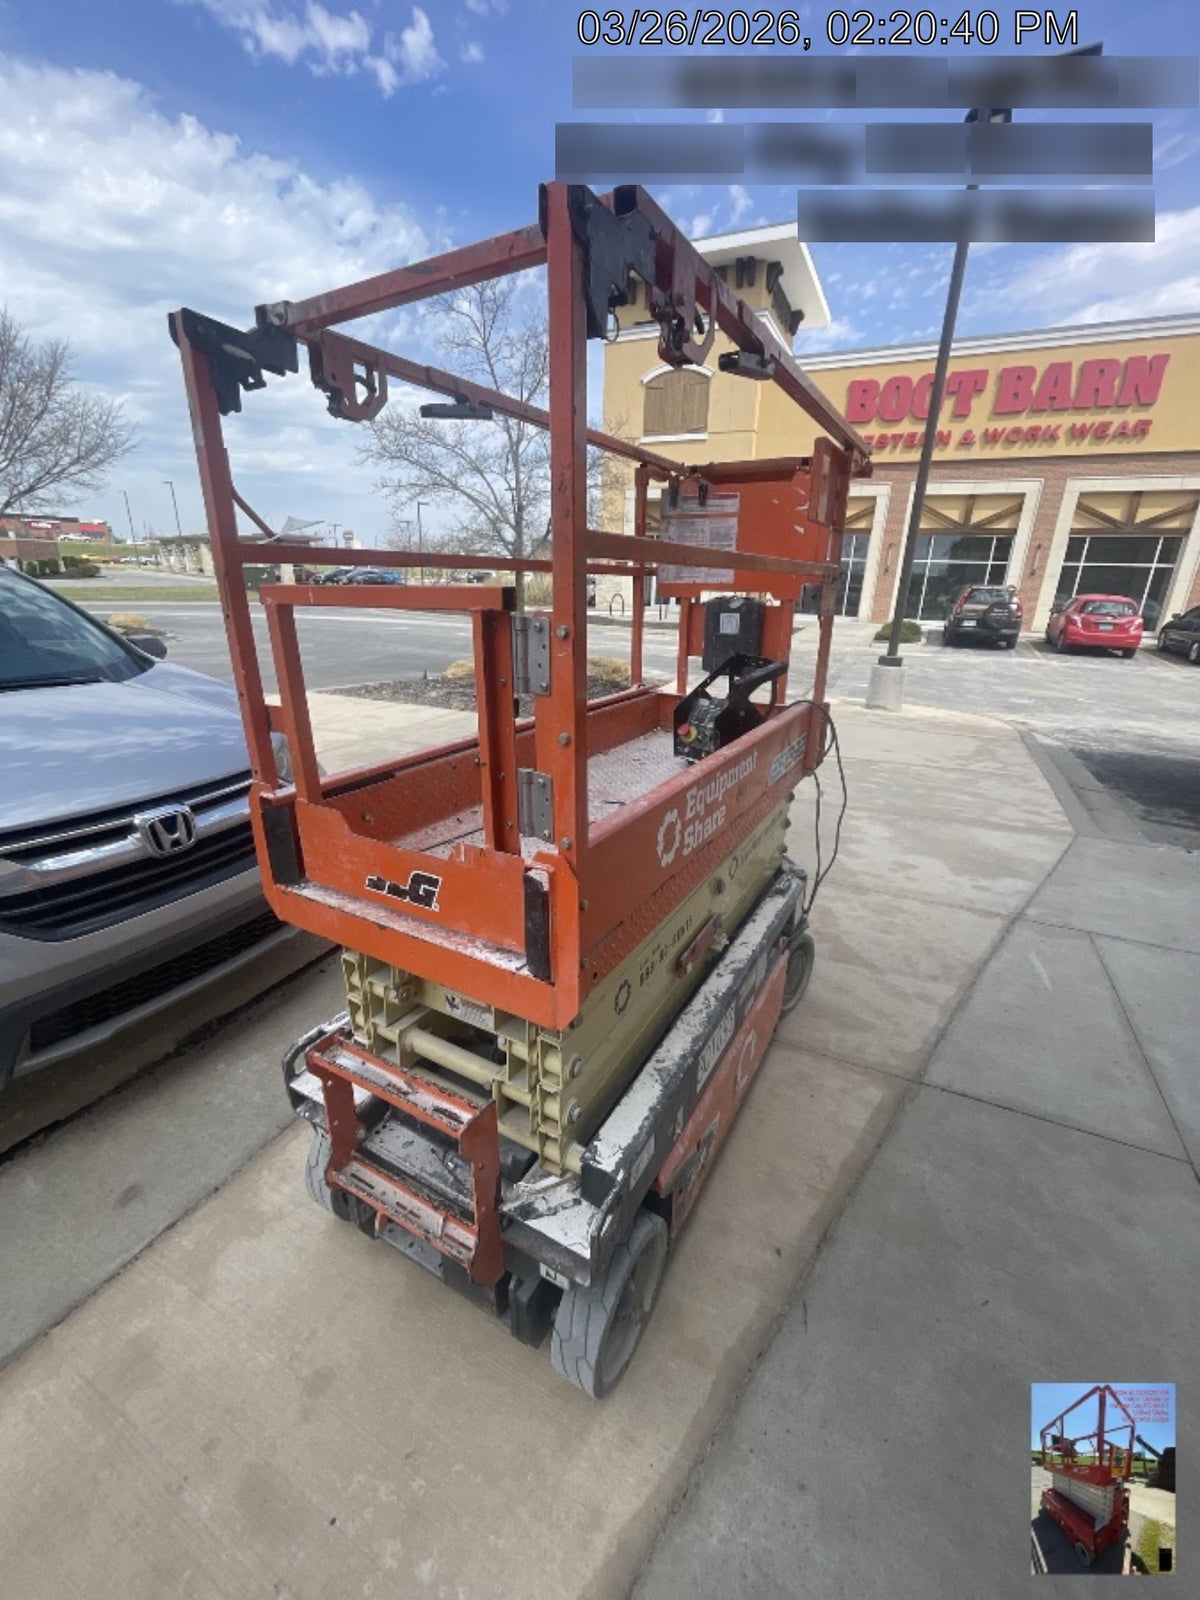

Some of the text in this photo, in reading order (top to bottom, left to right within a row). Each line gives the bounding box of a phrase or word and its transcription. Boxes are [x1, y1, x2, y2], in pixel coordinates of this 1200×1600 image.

[845, 353, 1171, 424] BOOT BARN
[863, 418, 1153, 451] ESTEN & WORK WEAR
[685, 750, 758, 821] Equipment
[682, 804, 727, 856] Share
